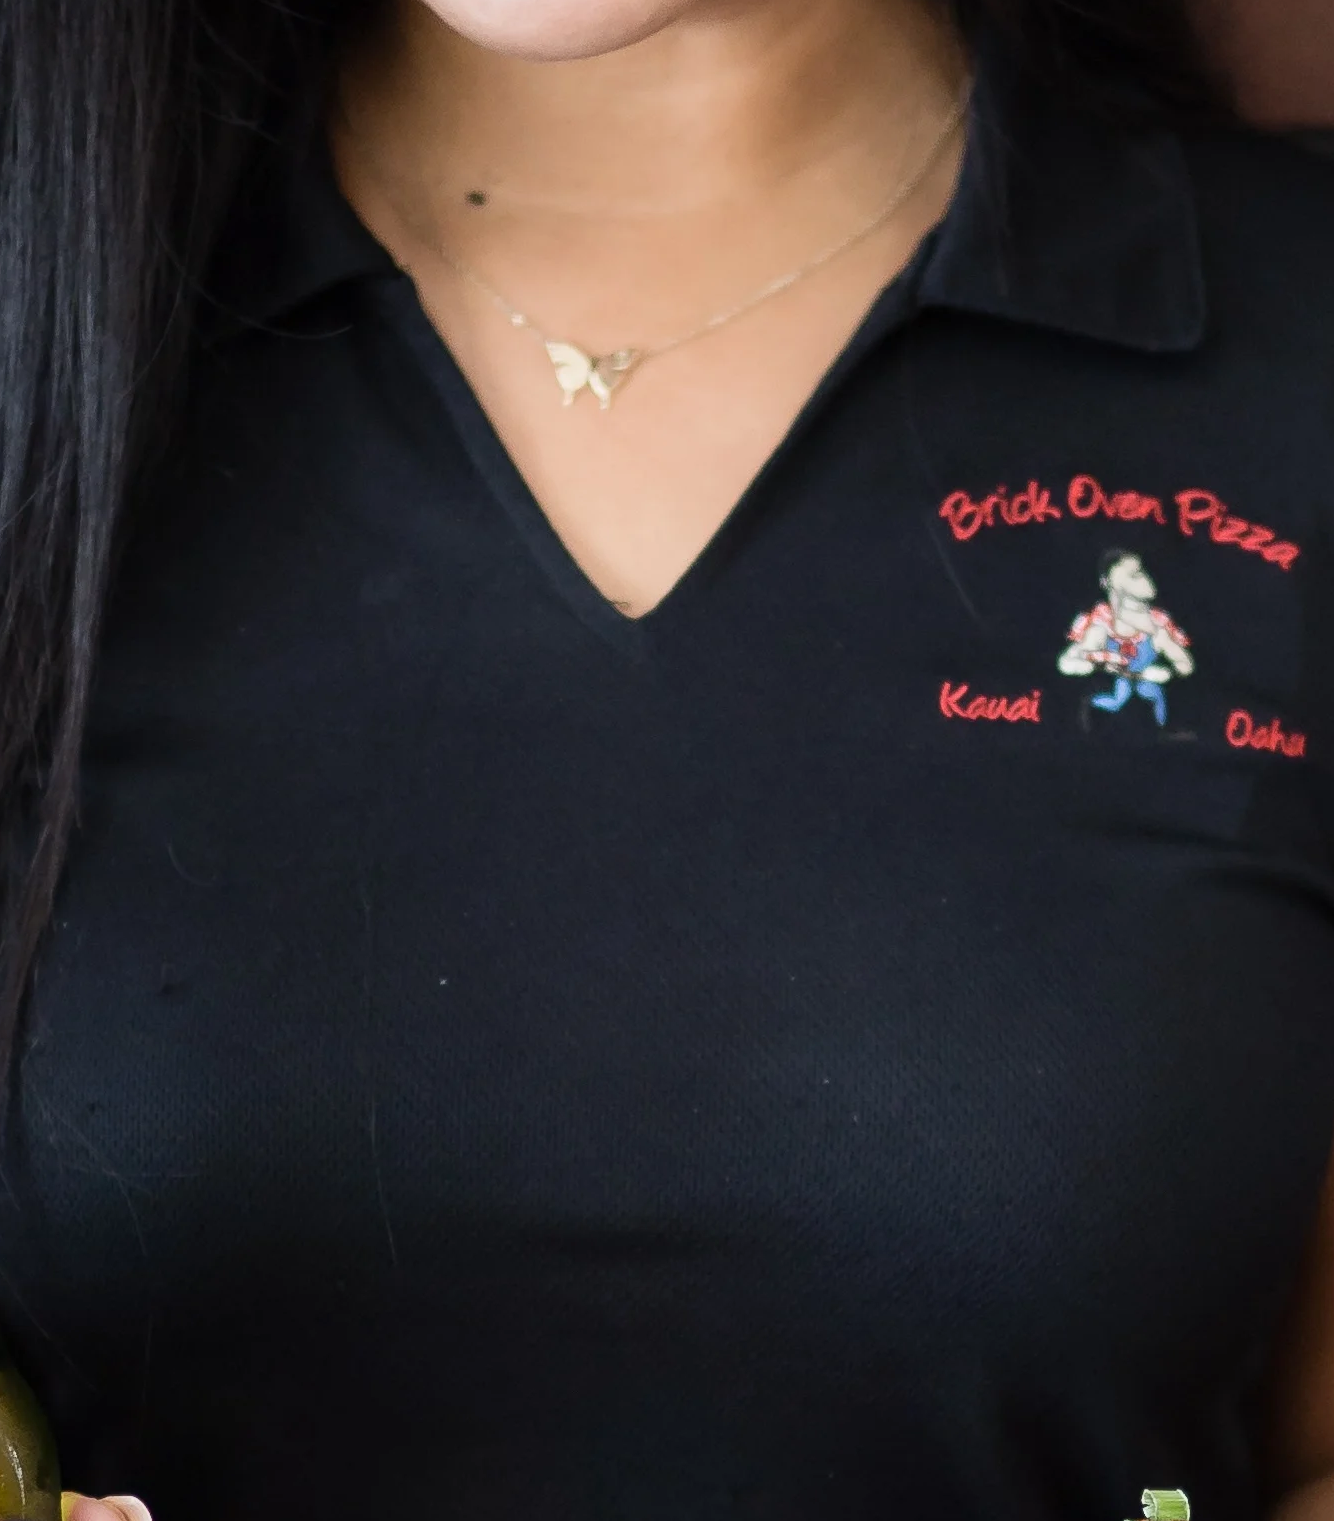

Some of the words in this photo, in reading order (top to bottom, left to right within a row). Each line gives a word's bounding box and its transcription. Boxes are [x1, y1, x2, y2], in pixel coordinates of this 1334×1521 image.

[939, 479, 1062, 540] Brick
[1068, 474, 1166, 525] Oven
[1174, 488, 1300, 571] Pizza
[939, 681, 1042, 723] Kauai
[1225, 709, 1306, 757] Oahu
